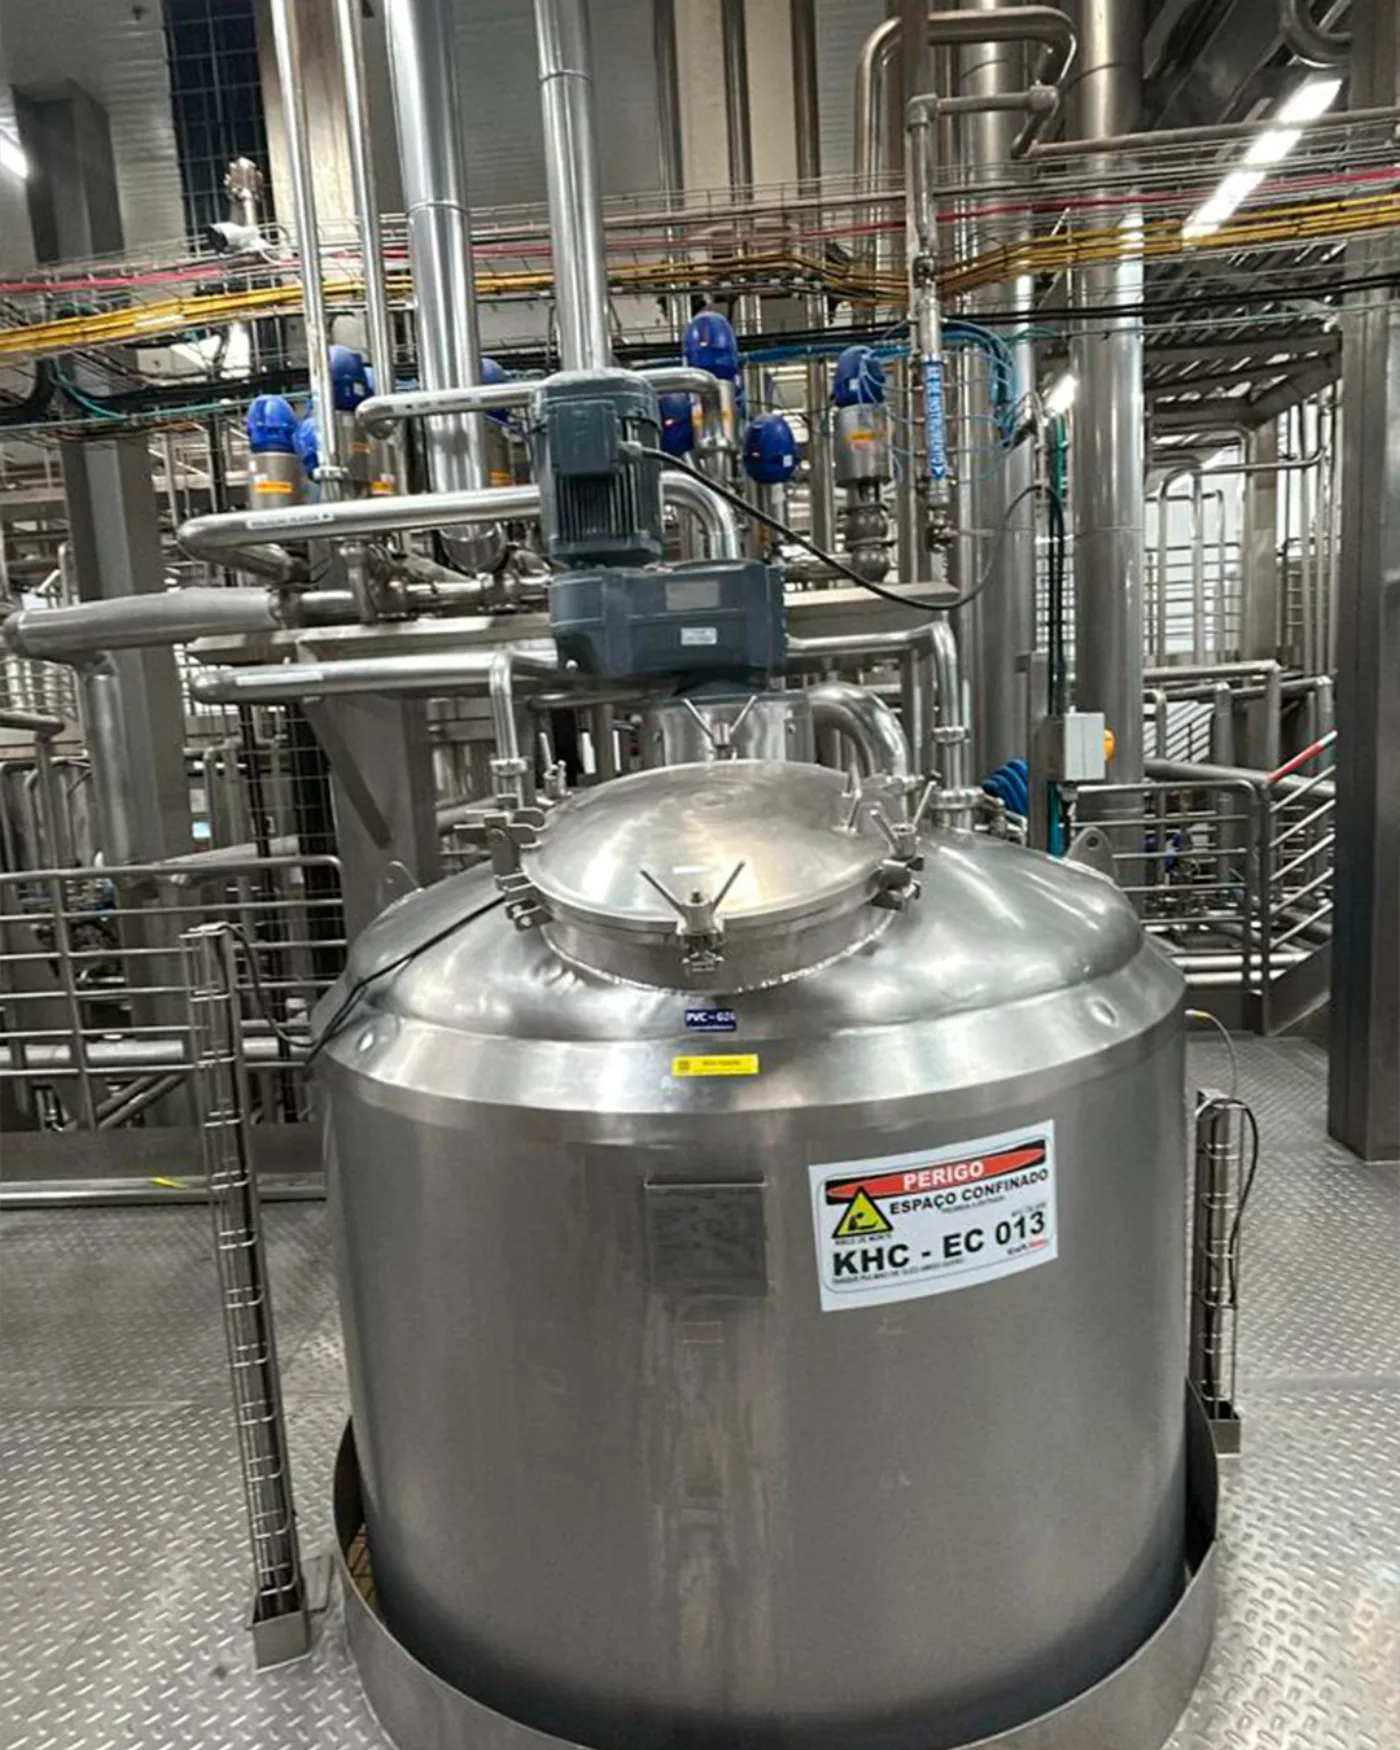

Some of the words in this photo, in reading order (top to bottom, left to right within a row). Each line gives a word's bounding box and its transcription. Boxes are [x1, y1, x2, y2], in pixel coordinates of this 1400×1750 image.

[889, 1193, 957, 1215] ESPAÇO
[962, 1168, 1049, 1202] CONFINADO
[902, 1161, 984, 1191] PERIGO
[832, 1244, 910, 1276] KHC
[943, 1228, 984, 1258] EC
[995, 1211, 1045, 1246] 013
